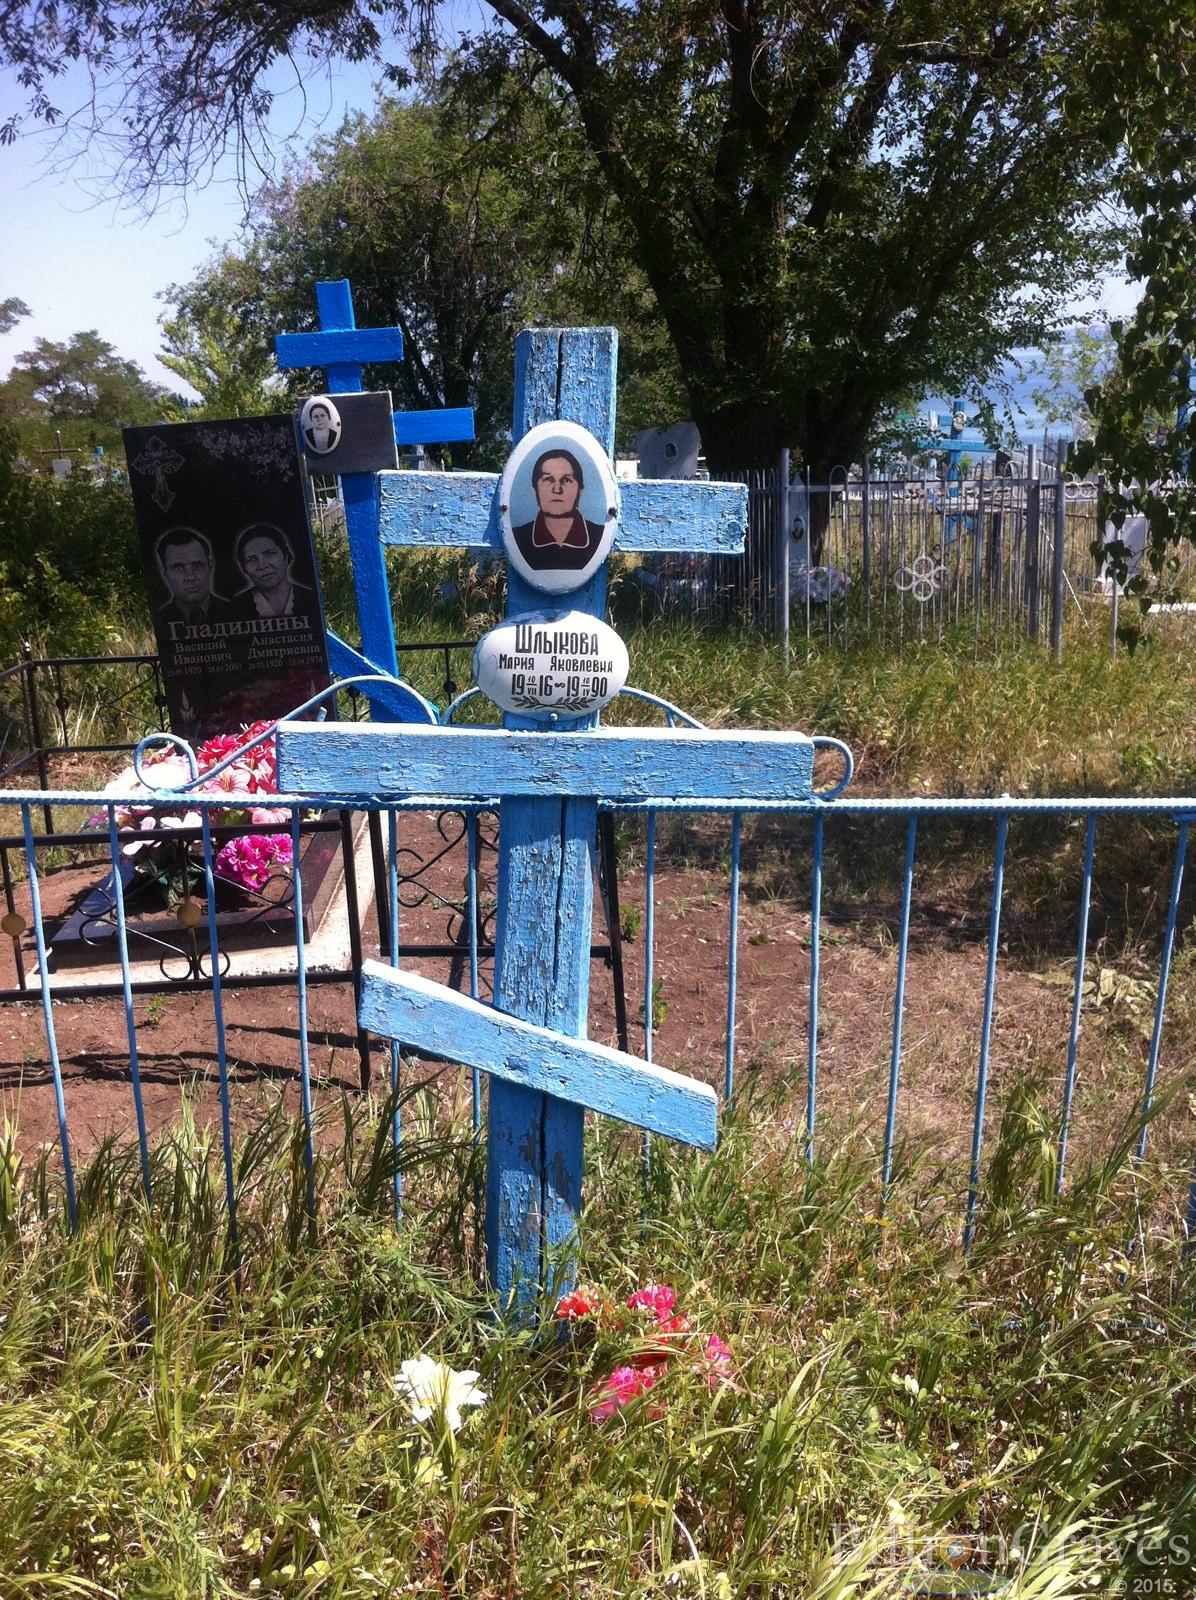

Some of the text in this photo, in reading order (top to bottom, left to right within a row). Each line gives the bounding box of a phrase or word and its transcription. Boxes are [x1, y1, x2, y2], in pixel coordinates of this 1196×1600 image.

[167, 615, 311, 641] Гладилины
[175, 639, 227, 653] Василий
[251, 633, 313, 647] Анастасия
[173, 652, 232, 666] Иванович
[247, 644, 320, 660] Дмитриевна
